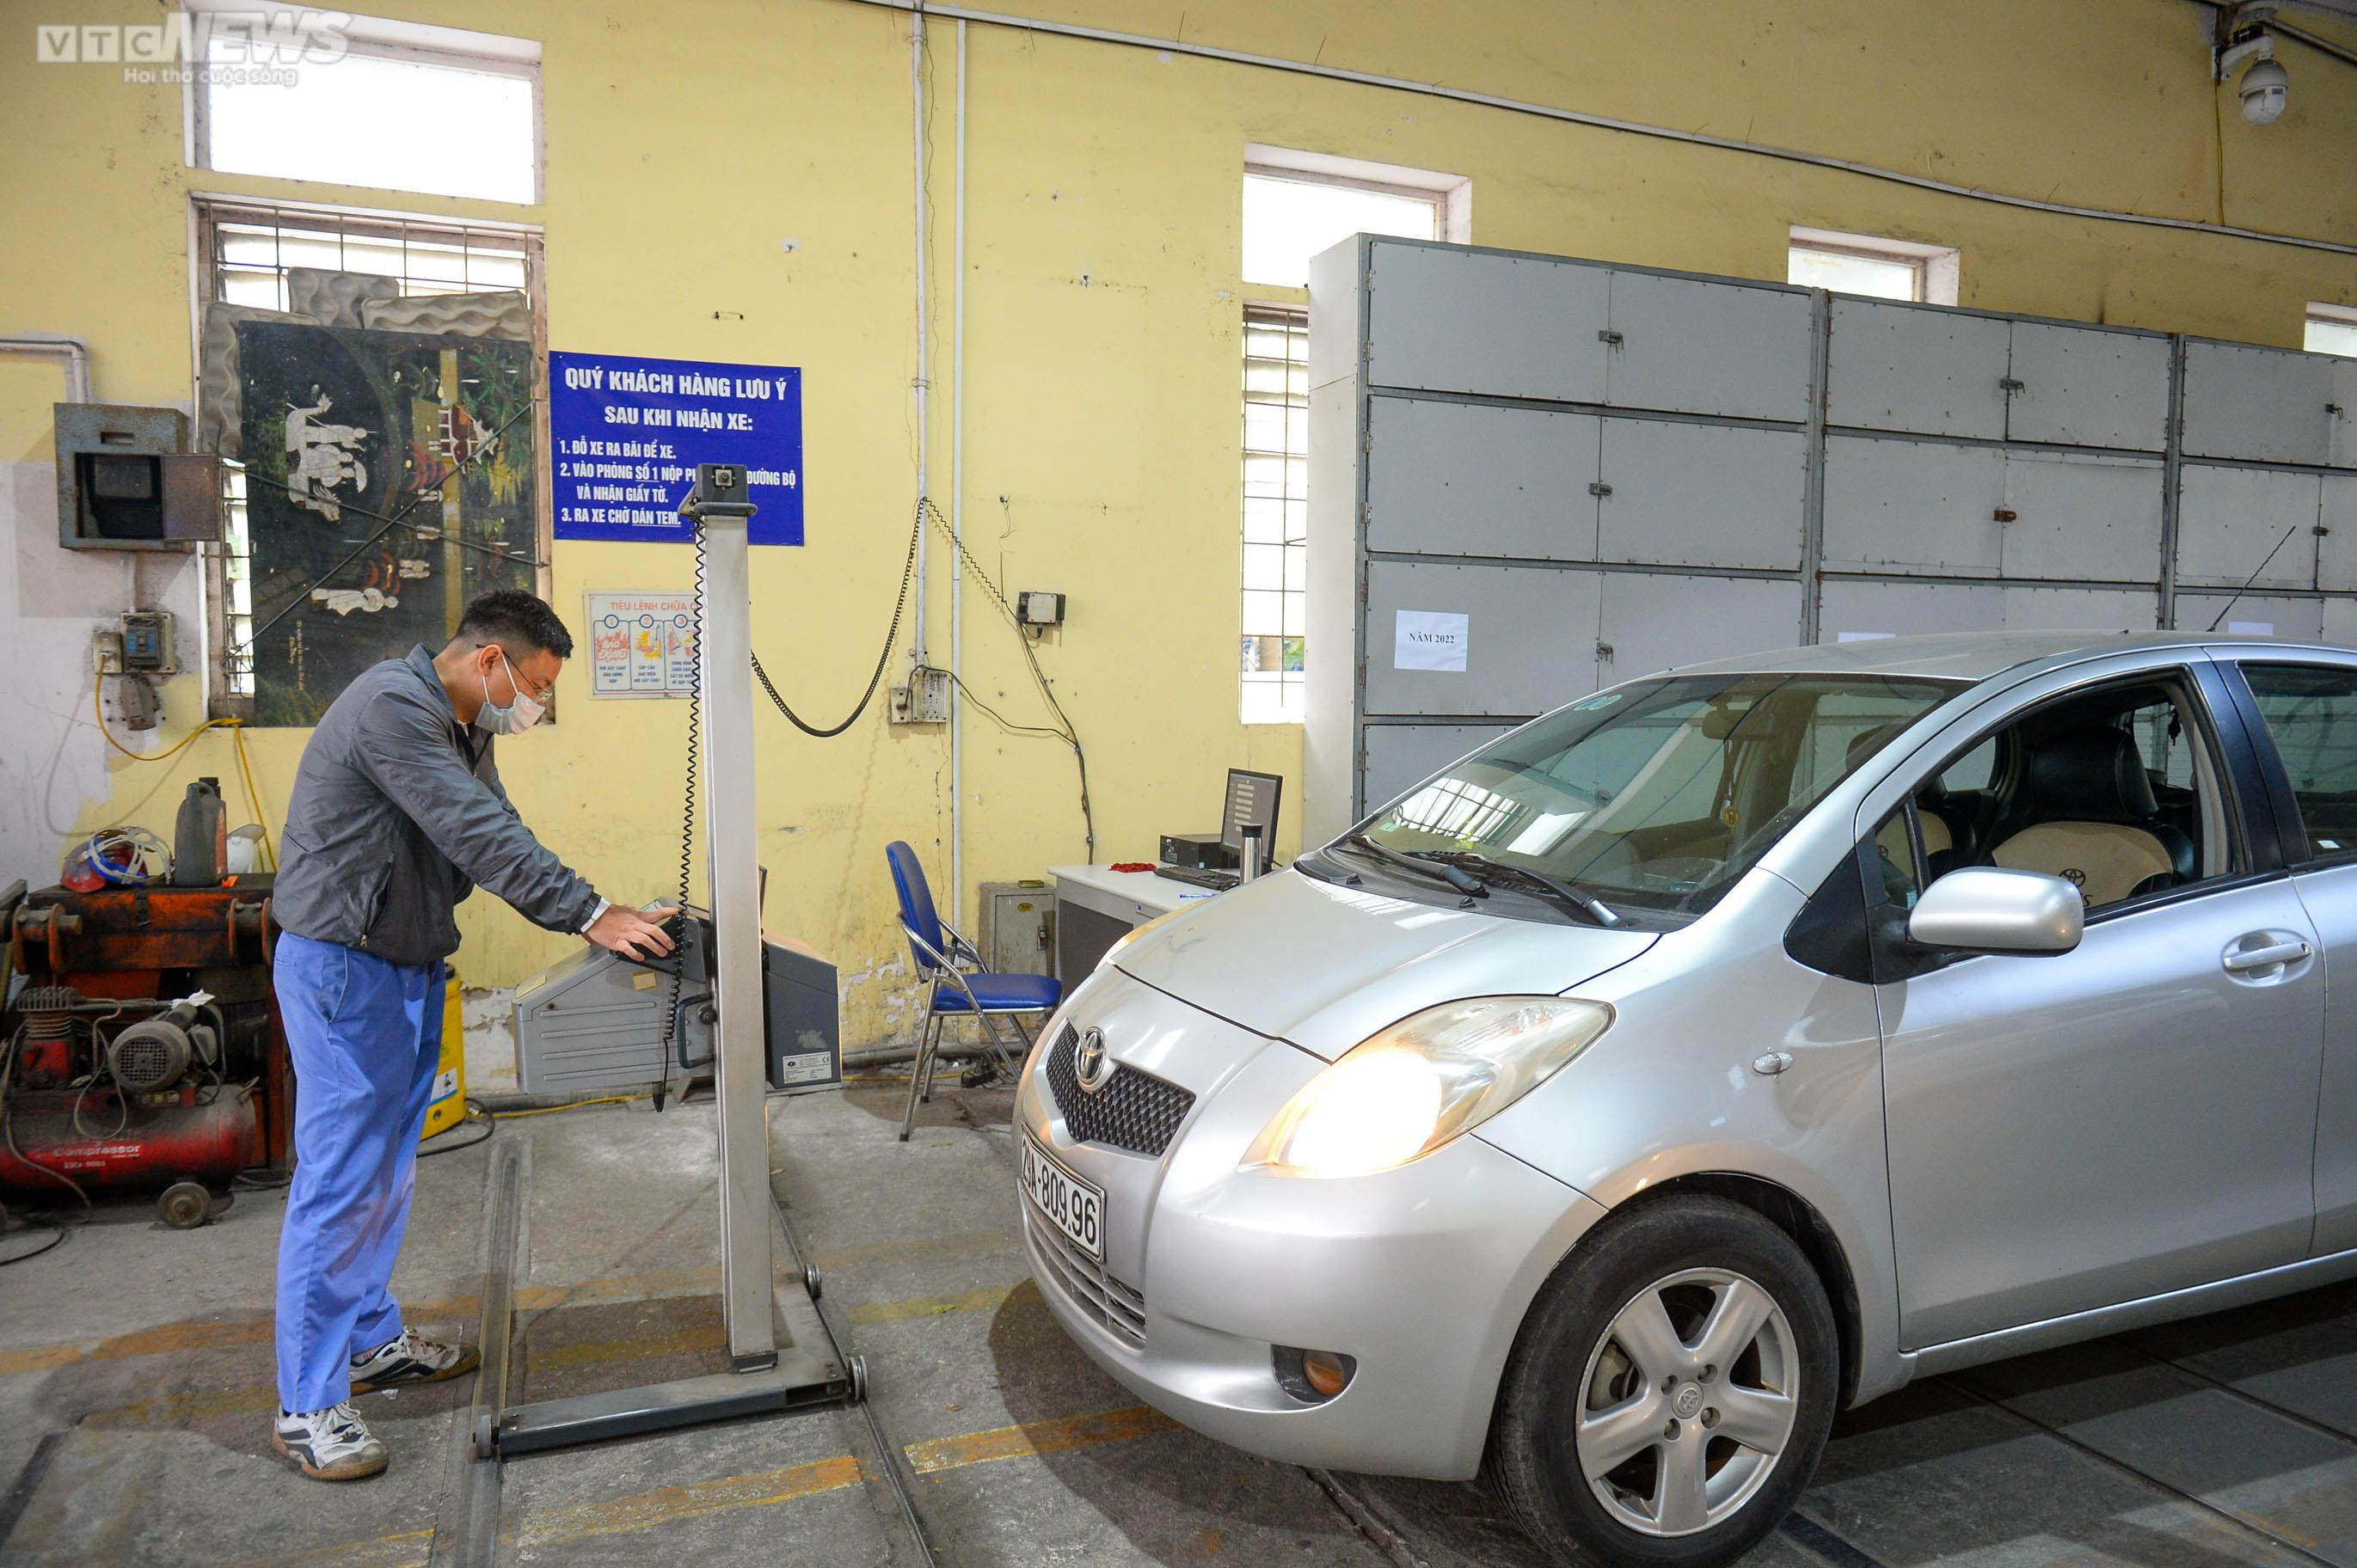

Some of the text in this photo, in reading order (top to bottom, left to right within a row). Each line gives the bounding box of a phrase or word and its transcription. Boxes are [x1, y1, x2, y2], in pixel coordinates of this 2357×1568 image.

[565, 365, 787, 401] QUÝ KHÁCH HÀNG LƯU Ý
[605, 406, 753, 432] SAU KHI NHẬN XE:
[560, 435, 677, 459] 1. ĐỖ XE RA BÃI ĐỂ XE.
[560, 462, 570, 477] 2.
[573, 460, 594, 478] VÀO
[596, 461, 633, 480] PHÒNG
[635, 461, 650, 480] SỐ
[652, 466, 658, 480] 1
[660, 464, 683, 484] NỘP
[746, 468, 796, 489] ĐƯỜNG BỘ
[576, 482, 669, 504] VÀ NHẬN GIẤY TỜ.
[561, 505, 681, 525] 3. RA XE CHỜ DÁN TEM.
[1409, 631, 1455, 644] NĂM 2022
[53, 1145, 141, 1157] Compressor
[1022, 1138, 1096, 1246] 29A-809.96
